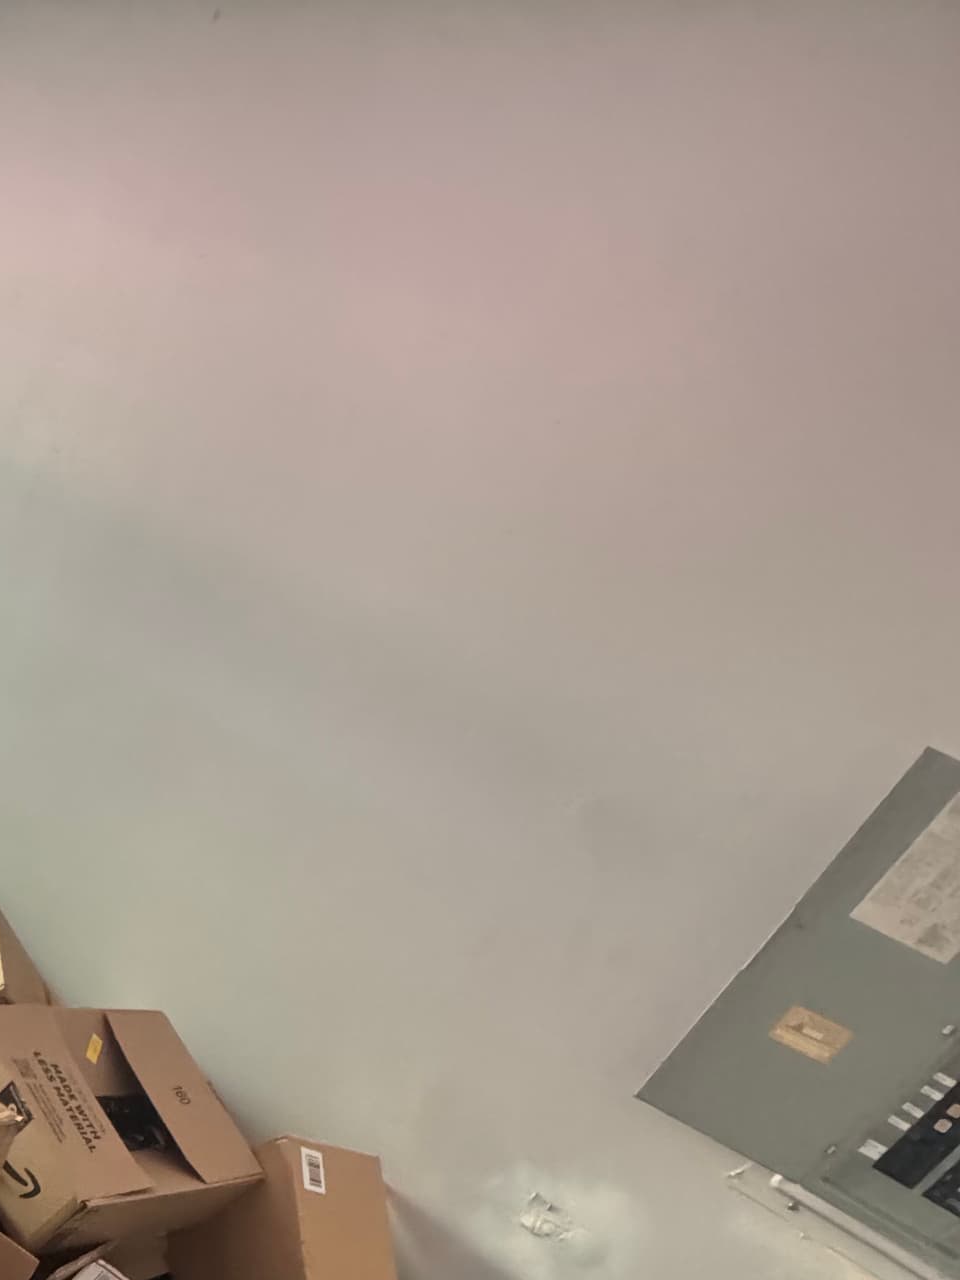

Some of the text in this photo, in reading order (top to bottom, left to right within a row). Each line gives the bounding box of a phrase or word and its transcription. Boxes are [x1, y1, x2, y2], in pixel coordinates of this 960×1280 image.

[32, 1050, 57, 1083] LESS
[52, 1085, 97, 1154] MATERIAL
[49, 1063, 102, 1141] MADE WITH
